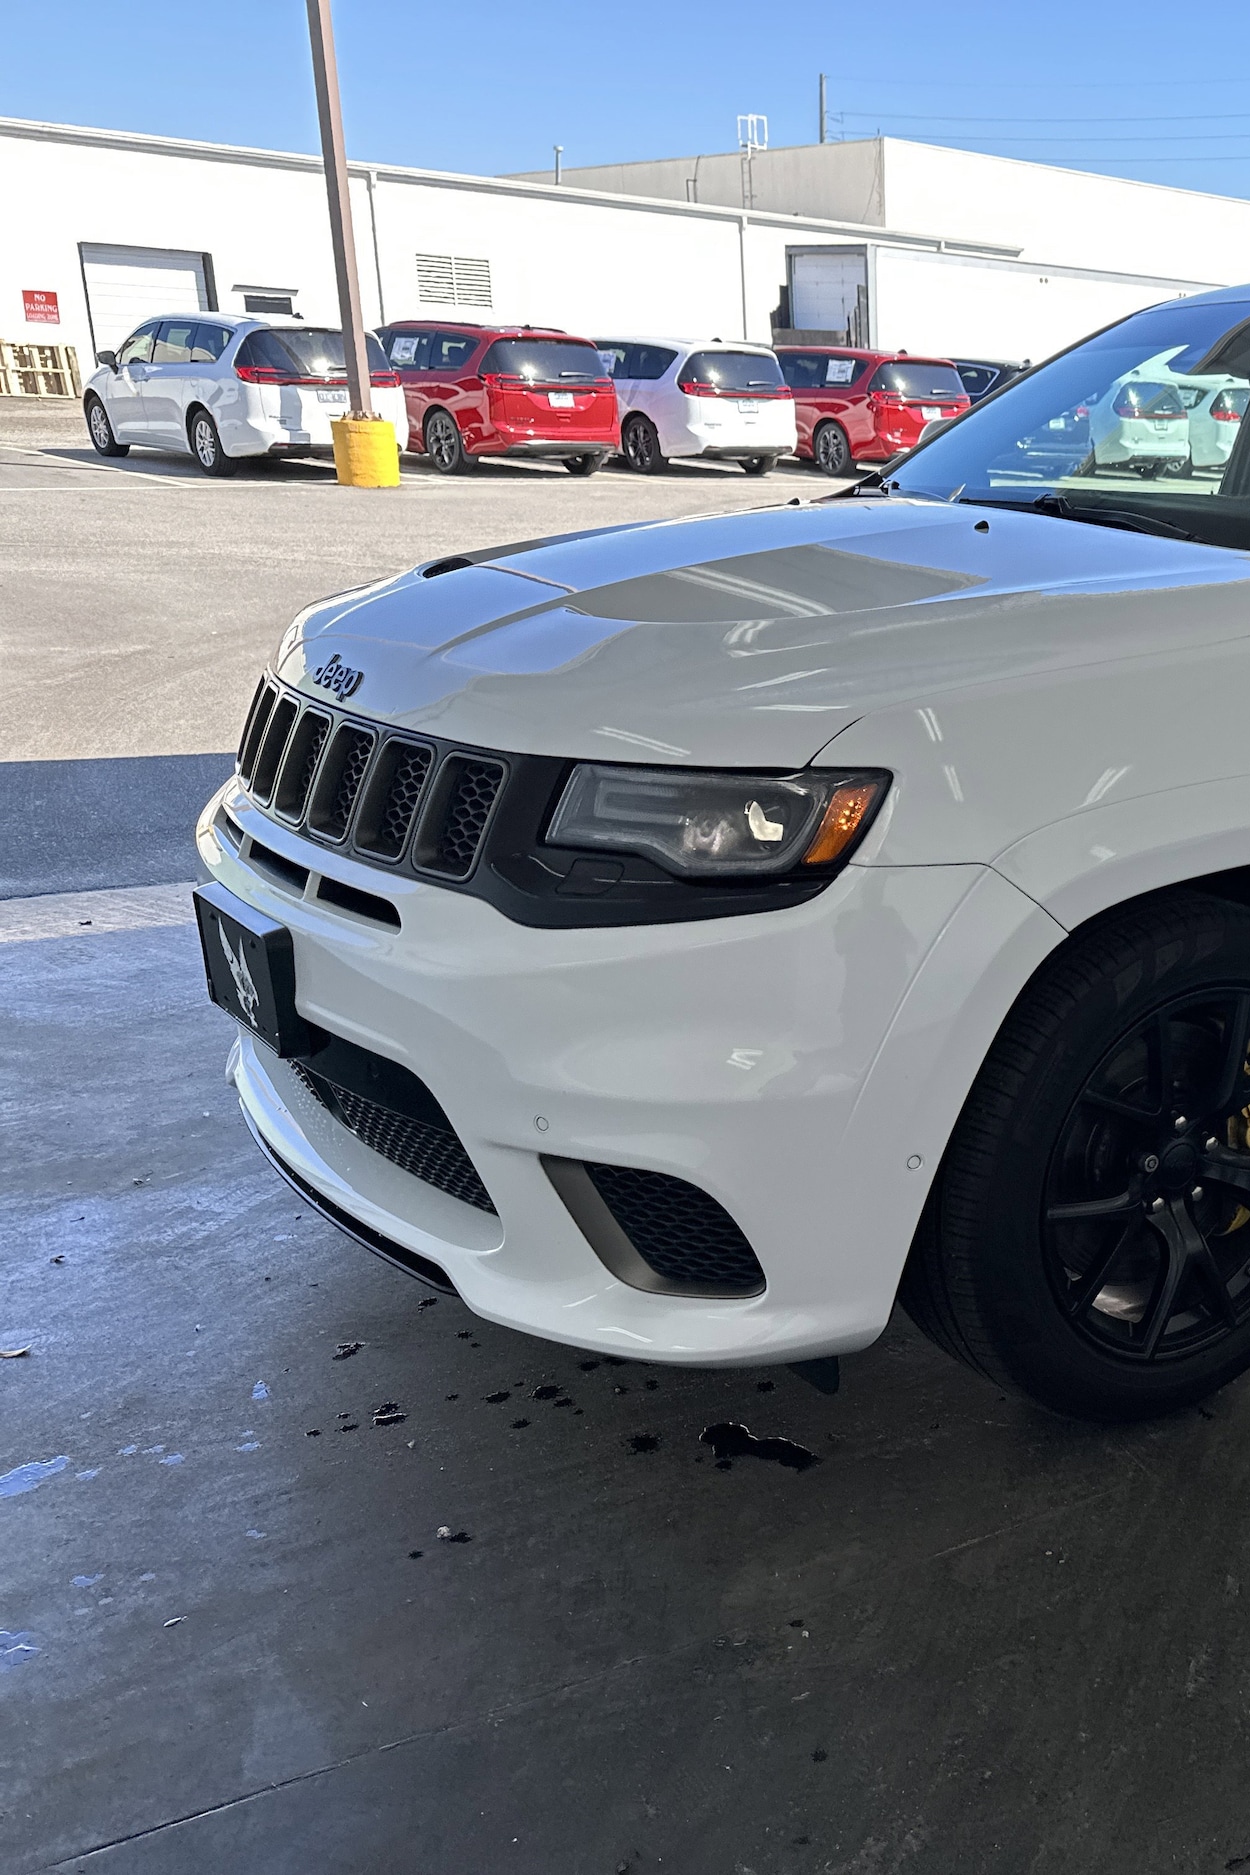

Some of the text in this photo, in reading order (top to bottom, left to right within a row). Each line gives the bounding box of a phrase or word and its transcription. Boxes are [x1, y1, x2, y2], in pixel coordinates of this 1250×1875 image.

[34, 293, 46, 302] NO
[25, 303, 58, 313] PARKING
[313, 653, 364, 703] Jeep
